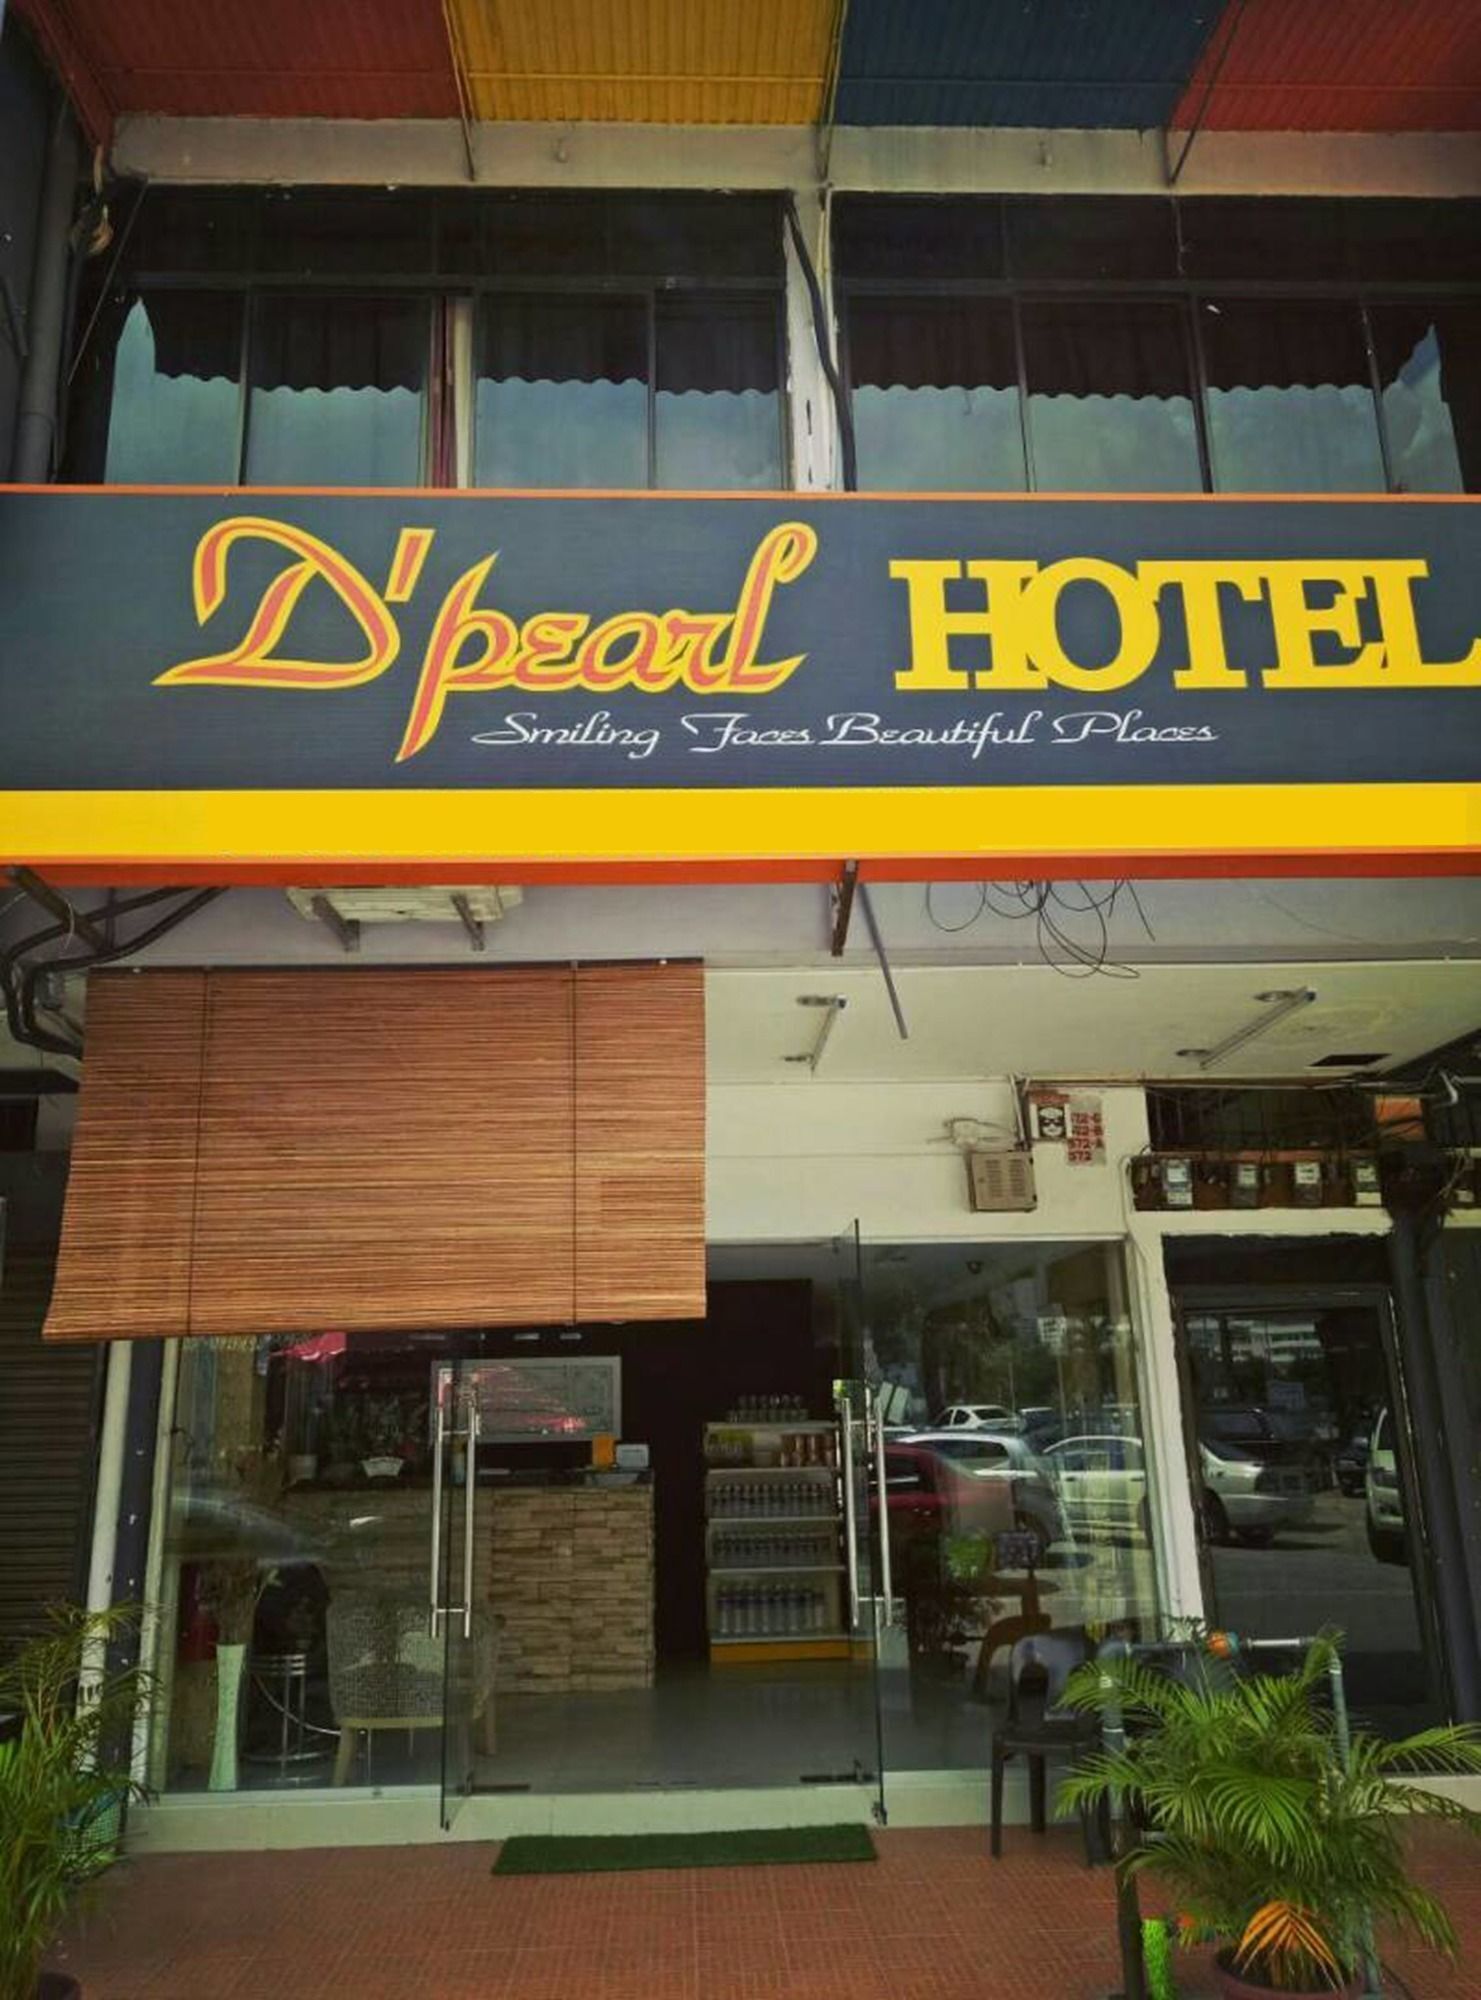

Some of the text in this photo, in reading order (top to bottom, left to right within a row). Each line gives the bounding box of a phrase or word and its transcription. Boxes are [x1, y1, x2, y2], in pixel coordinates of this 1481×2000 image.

[890, 558, 1481, 691] HOTEL
[472, 709, 1220, 758] Smiling Faces Beautiful Places
